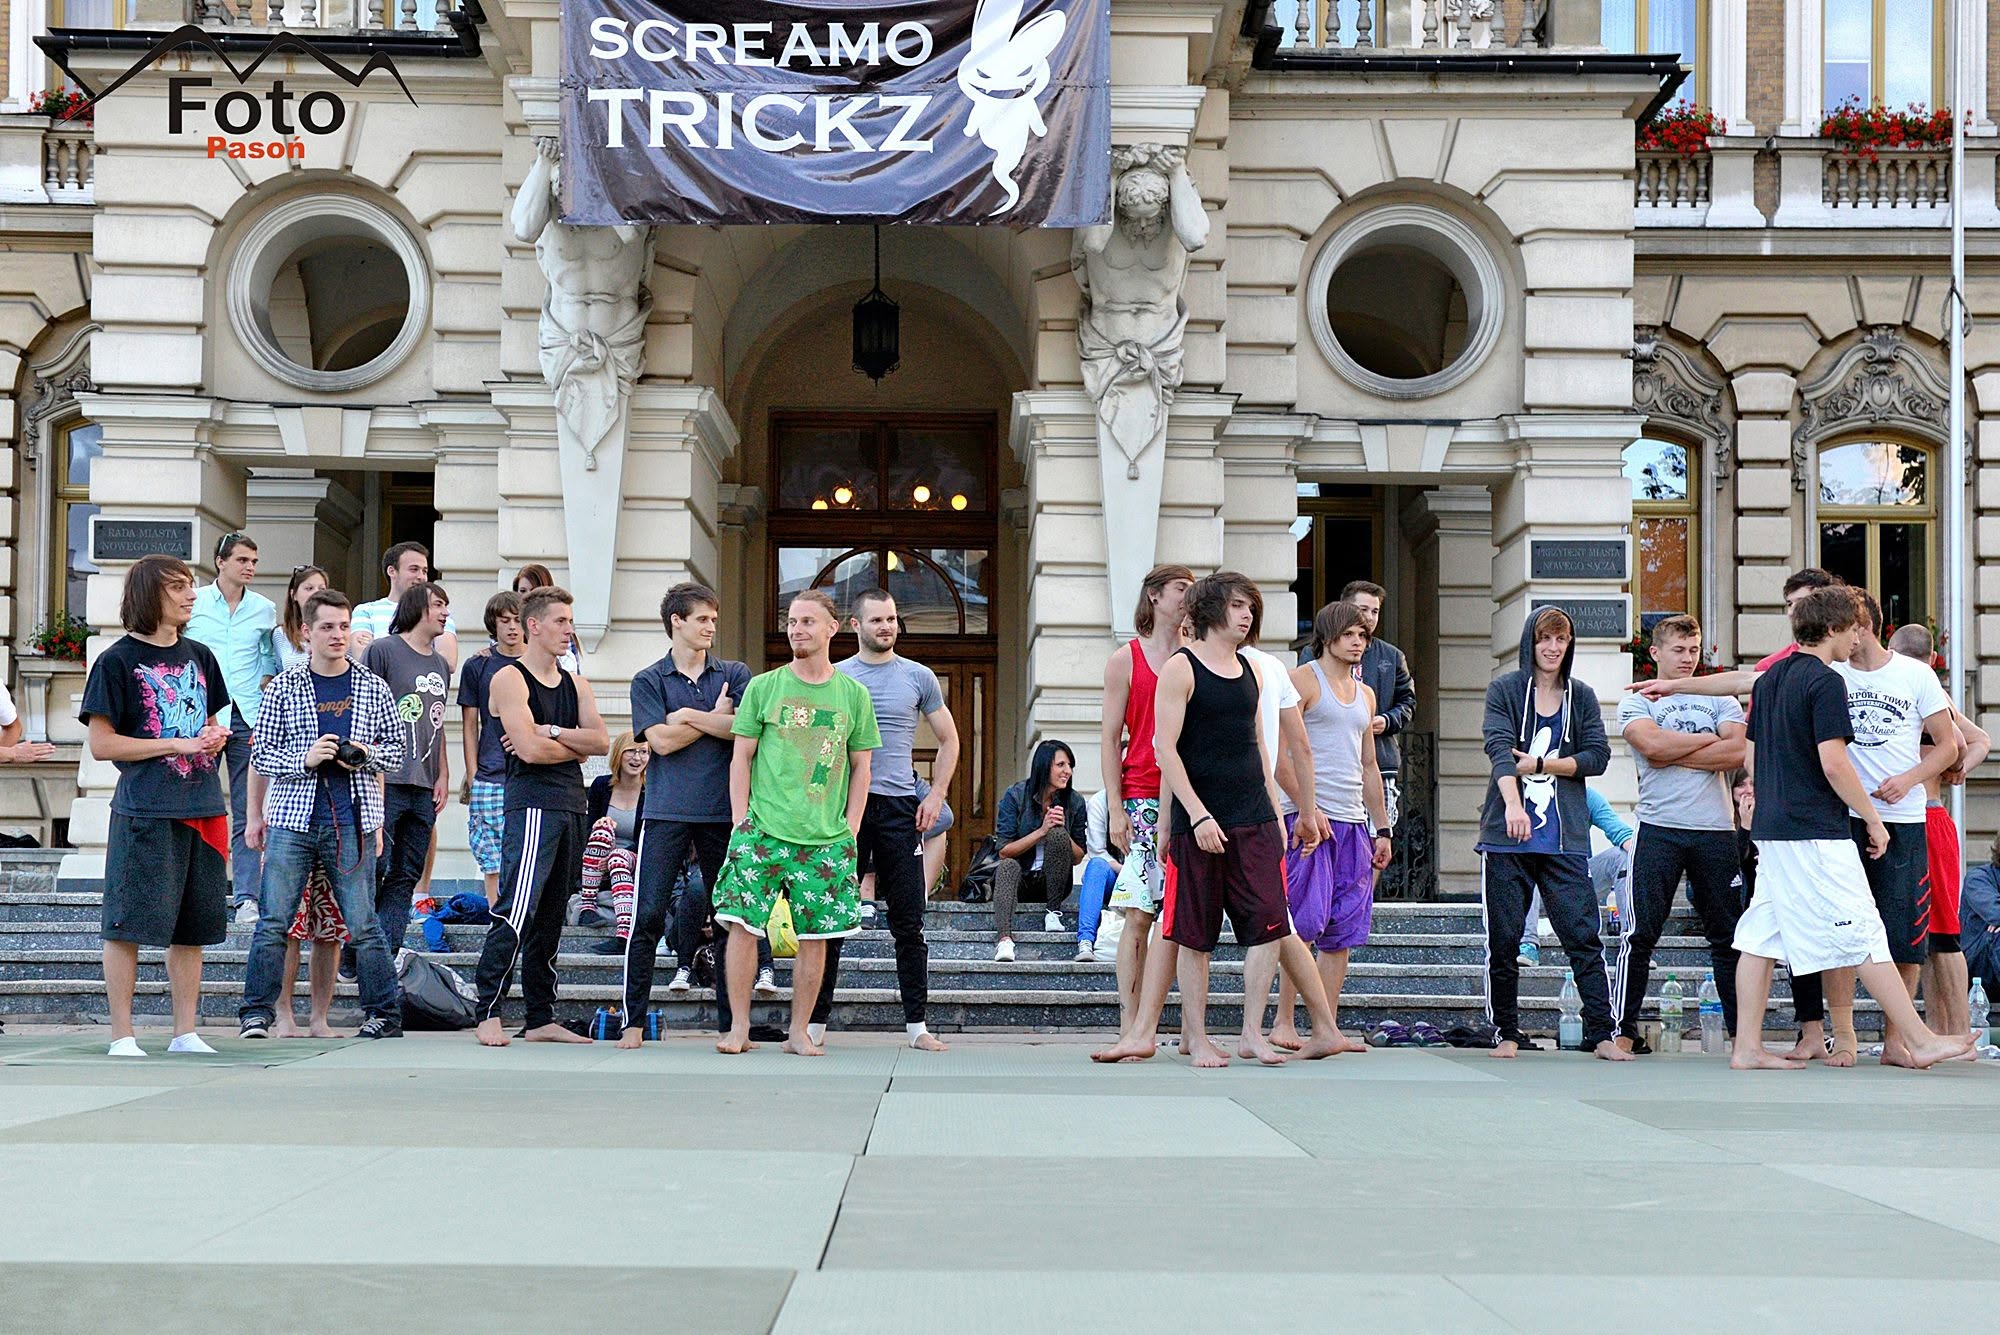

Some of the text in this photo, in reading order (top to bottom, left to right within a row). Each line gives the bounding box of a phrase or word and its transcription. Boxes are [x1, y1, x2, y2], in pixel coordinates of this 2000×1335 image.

[589, 17, 933, 68] SCREAMO
[587, 86, 934, 153] TRICKZ
[108, 527, 178, 539] RADA MIASTA
[102, 541, 149, 552] NOWEGO
[1588, 548, 1620, 557] MIASTA
[1542, 561, 1585, 570] NOWEGO
[1578, 607, 1616, 617] MIASTA
[1882, 695, 1912, 711] TOWN
